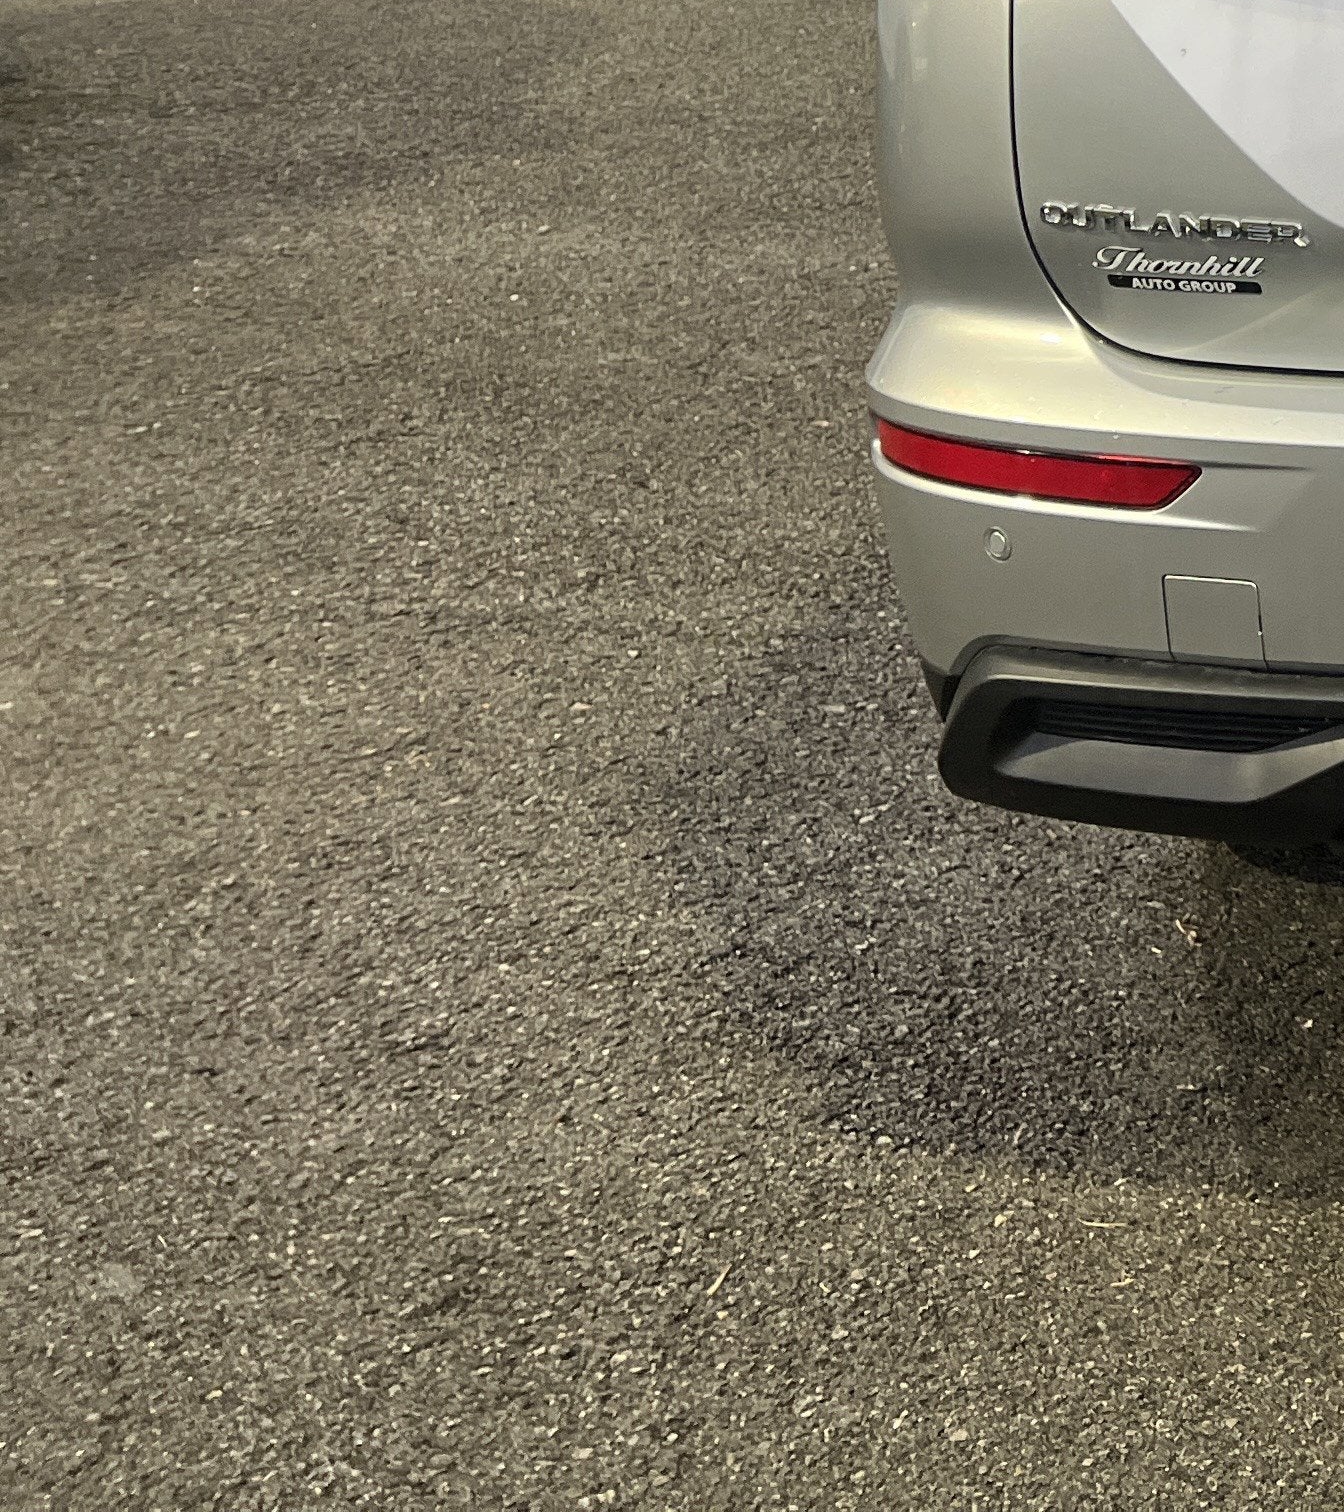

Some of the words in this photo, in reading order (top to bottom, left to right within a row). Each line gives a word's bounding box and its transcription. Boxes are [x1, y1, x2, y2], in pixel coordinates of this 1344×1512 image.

[1040, 200, 1310, 247] OUTLANDER
[1092, 245, 1266, 278] Thornhill
[1131, 277, 1175, 291] AUTO
[1178, 280, 1237, 294] GROUP
